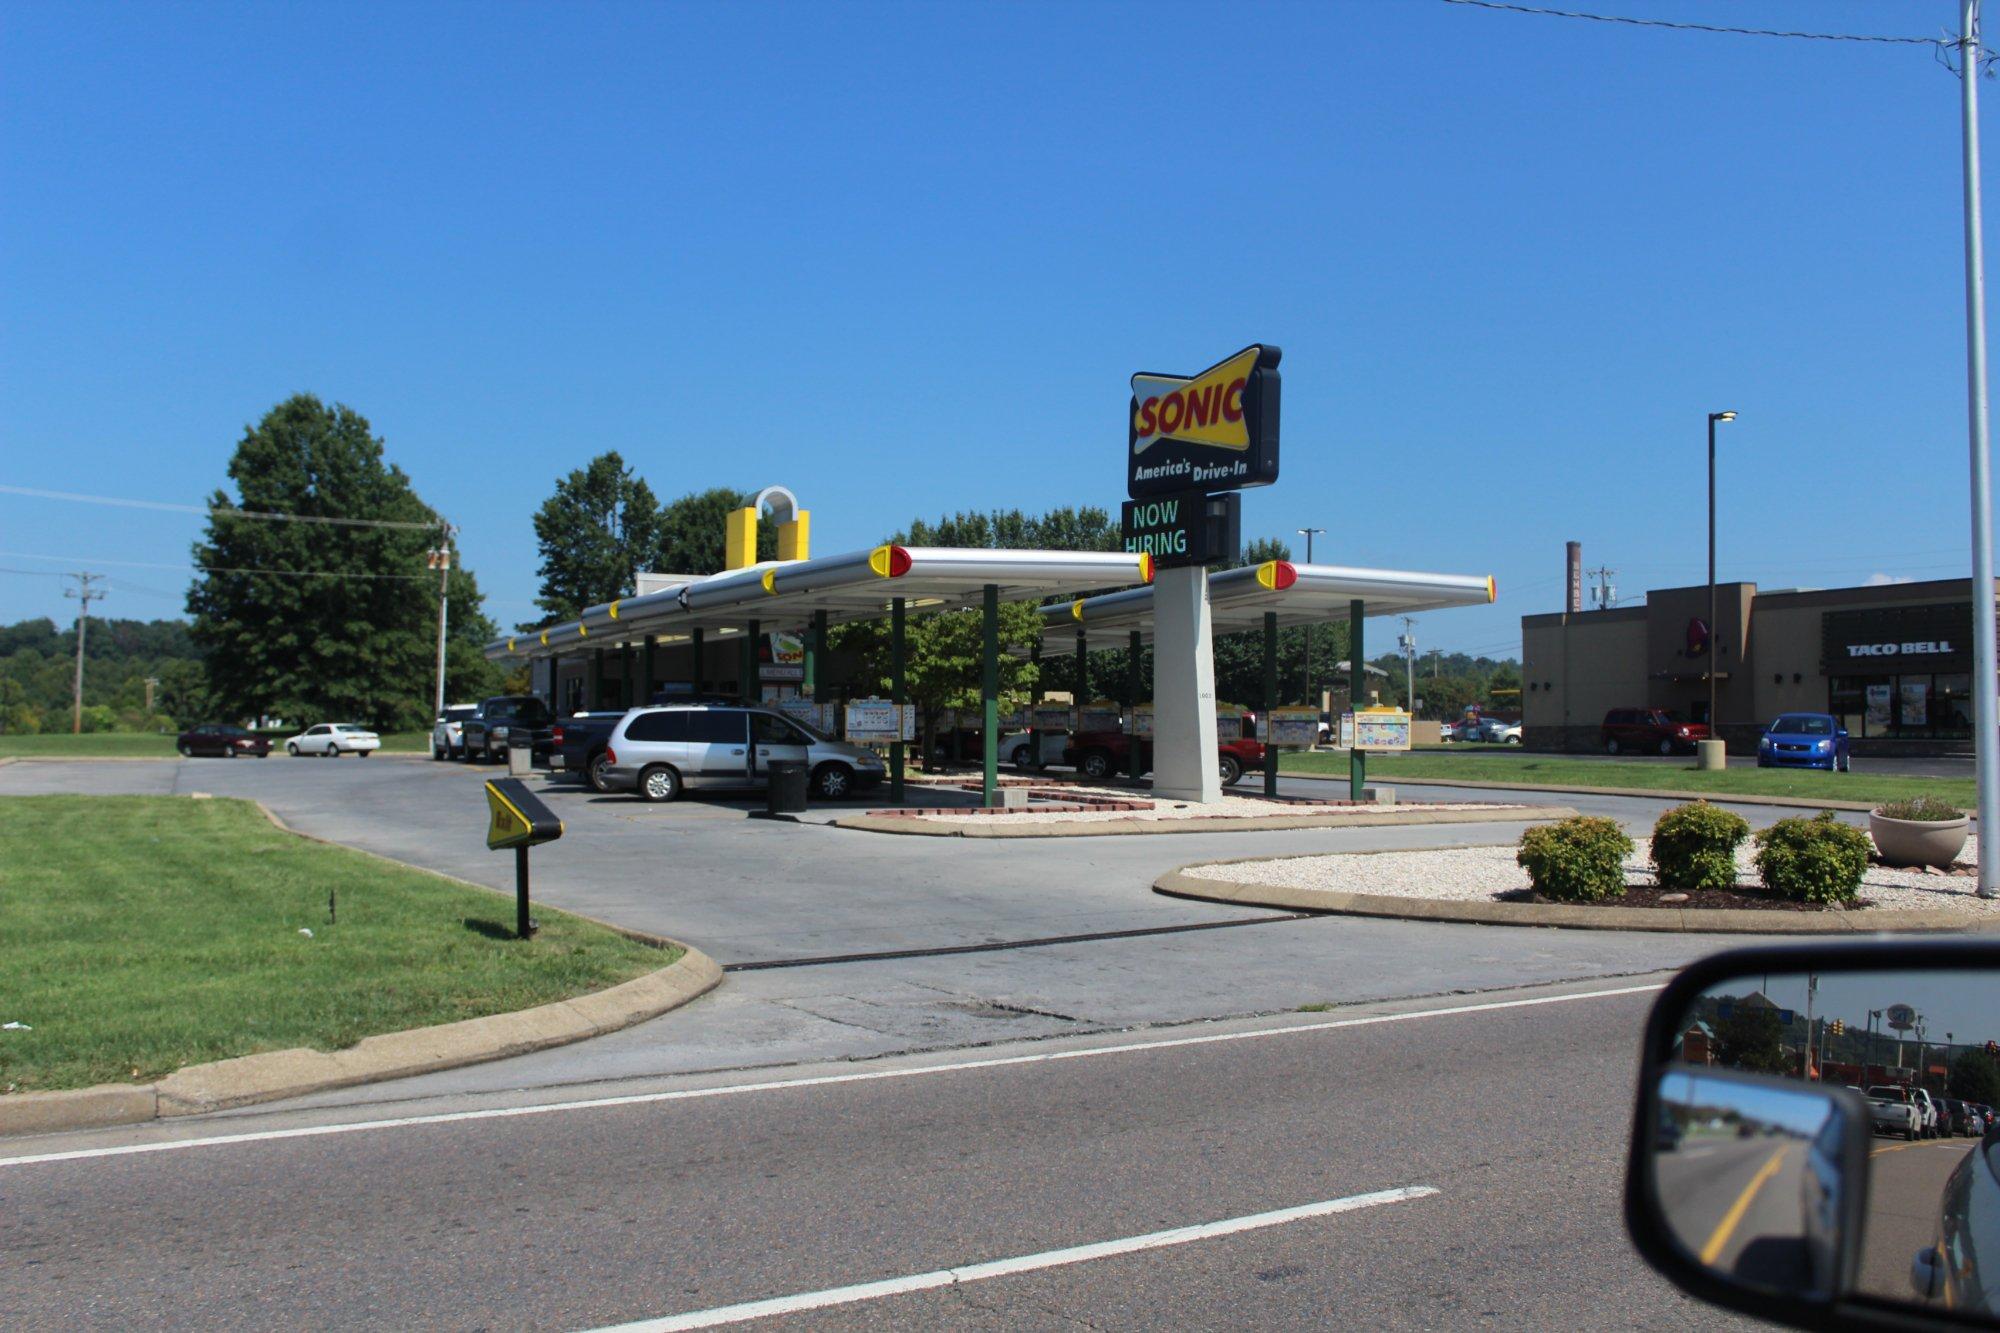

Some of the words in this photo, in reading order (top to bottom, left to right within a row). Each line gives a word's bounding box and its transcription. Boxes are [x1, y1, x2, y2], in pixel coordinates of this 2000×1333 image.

[1138, 377, 1246, 437] SONIC
[1135, 458, 1191, 481] America's
[1193, 460, 1247, 482] Drive-In
[1133, 500, 1179, 529] NOW
[1125, 529, 1186, 556] HIRING
[1846, 643, 1899, 657] TACO
[1901, 641, 1954, 654] BELL
